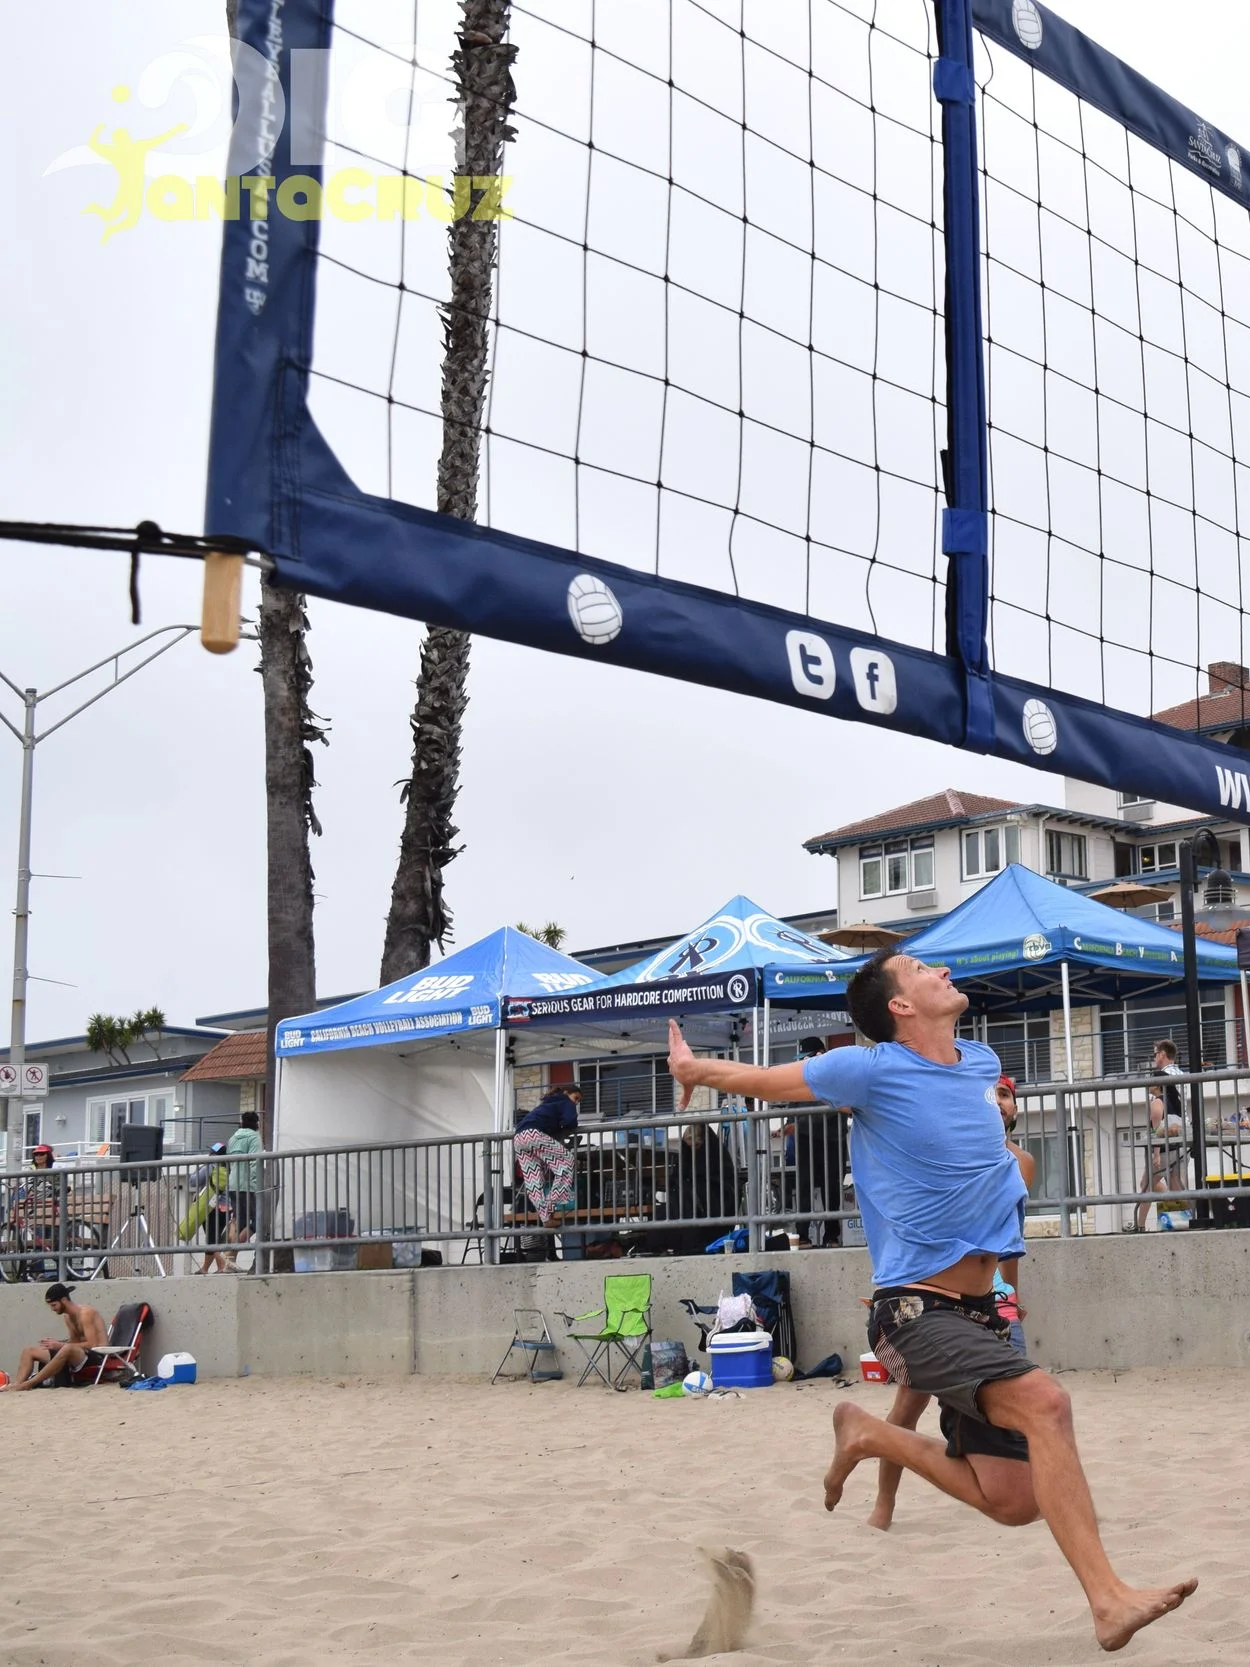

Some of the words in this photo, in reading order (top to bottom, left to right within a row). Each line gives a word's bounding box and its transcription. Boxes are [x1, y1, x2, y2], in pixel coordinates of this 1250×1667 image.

[414, 975, 474, 990] BUD
[531, 972, 593, 987] BUD
[382, 986, 471, 1004] LIGHT
[531, 999, 571, 1015] SERIOUS
[571, 996, 595, 1012] GEAR
[596, 994, 613, 1010] FOR
[614, 990, 660, 1007] HARDCORE
[662, 984, 724, 1004] COMPETITION
[471, 1005, 490, 1015] BUD
[468, 1013, 493, 1025] LIGHT
[284, 1029, 302, 1040] BUD
[310, 1025, 350, 1043] CALIFORNIA
[350, 1022, 374, 1038] BEACH
[374, 1017, 415, 1035] VOLLEYBALL
[415, 1012, 463, 1030] ASSOCIATION
[280, 1037, 304, 1049] LIGHT
